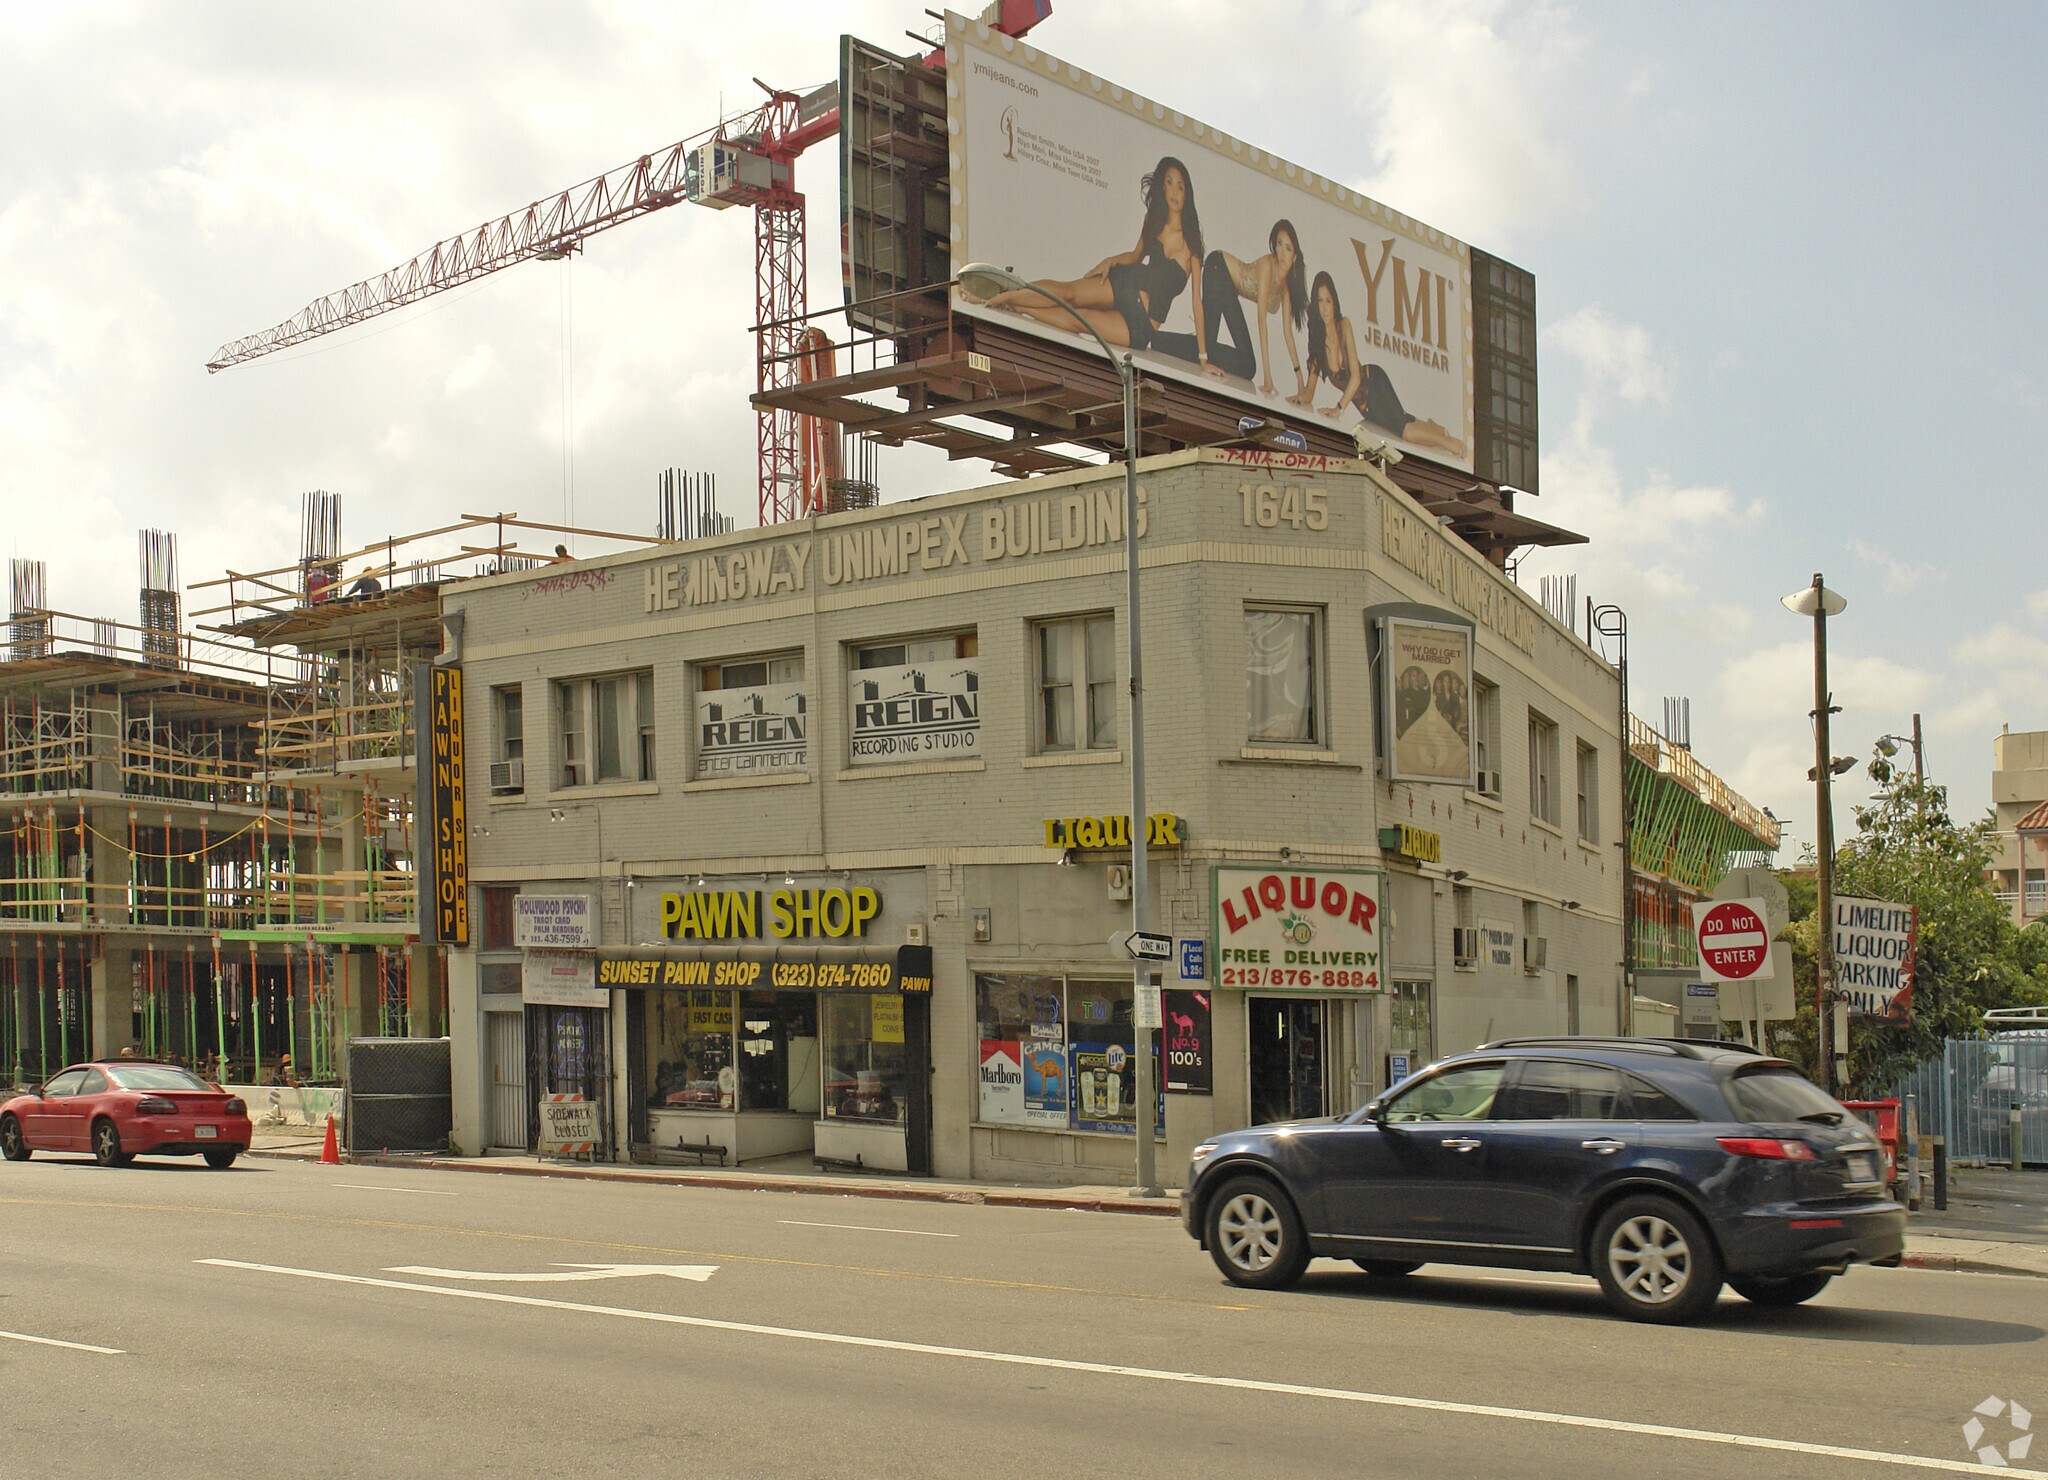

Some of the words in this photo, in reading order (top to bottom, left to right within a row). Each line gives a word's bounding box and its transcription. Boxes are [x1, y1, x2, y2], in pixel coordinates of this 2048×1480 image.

[973, 61, 1039, 98] ymijeans.com
[1016, 126, 1037, 141] Rachel
[1038, 135, 1057, 150] Smith,
[1058, 143, 1071, 155] Miss
[1072, 149, 1085, 161] USA
[1086, 155, 1100, 166] 2007
[1048, 149, 1062, 161] Miss
[1062, 153, 1088, 172] Universe
[1088, 165, 1102, 177] 2007
[1052, 160, 1066, 173] Miss
[1067, 166, 1081, 178] Teen
[1081, 172, 1095, 184] USA
[1095, 178, 1109, 190] 2007
[1350, 236, 1449, 352] YMI
[970, 353, 989, 370] 1070
[1364, 326, 1450, 374] JEANSWEAR
[1238, 482, 1329, 532] 1645
[822, 511, 970, 586] UNIMPEX
[1401, 643, 1422, 653] WHY
[1423, 646, 1438, 656] DID
[1444, 648, 1462, 658] GET
[1411, 652, 1451, 665] MARRIED
[855, 692, 979, 728] REIGN
[436, 671, 450, 788] PAWN
[450, 674, 461, 801] LIQUOR
[702, 715, 806, 747] REIGN
[852, 735, 919, 757] RECORDING
[924, 731, 976, 750] STUDIO
[440, 817, 455, 933] SHOP
[455, 818, 465, 923] STORE
[519, 899, 560, 915] HOLLYWOOD
[660, 890, 760, 939] PAWN
[768, 886, 881, 938] SHOP
[1220, 874, 1377, 936] LIQUOR
[533, 916, 553, 924] TAROT
[554, 916, 571, 925] CARD
[533, 925, 550, 934] PALM
[552, 925, 584, 935] READINGS
[1707, 919, 1724, 933] DO
[1732, 916, 1755, 931] NOT
[1837, 904, 1913, 934] LIMELITE
[544, 934, 581, 944] 436-7599
[1140, 940, 1154, 952] ONE
[1155, 941, 1169, 954] WAY
[1836, 932, 1912, 963] LIQUOR
[1222, 948, 1271, 963] FREE
[1284, 950, 1379, 966] DELIVERY
[1714, 949, 1757, 965] ENTER
[600, 960, 661, 985] SUNSET
[663, 961, 711, 986] PAWN
[714, 961, 761, 986] SHOP
[900, 976, 930, 992] PAWN
[1222, 967, 1379, 988] 213/876-8884
[1835, 960, 1909, 990] PARKING
[1839, 989, 1893, 1017] ONLY
[693, 1011, 711, 1024] FAST
[1108, 1052, 1124, 1067] Lite
[1169, 1051, 1202, 1066] 100's
[980, 1063, 1022, 1085] Marlboro
[546, 1107, 592, 1122] SIDEWALK
[553, 1124, 589, 1138] CLOSED
